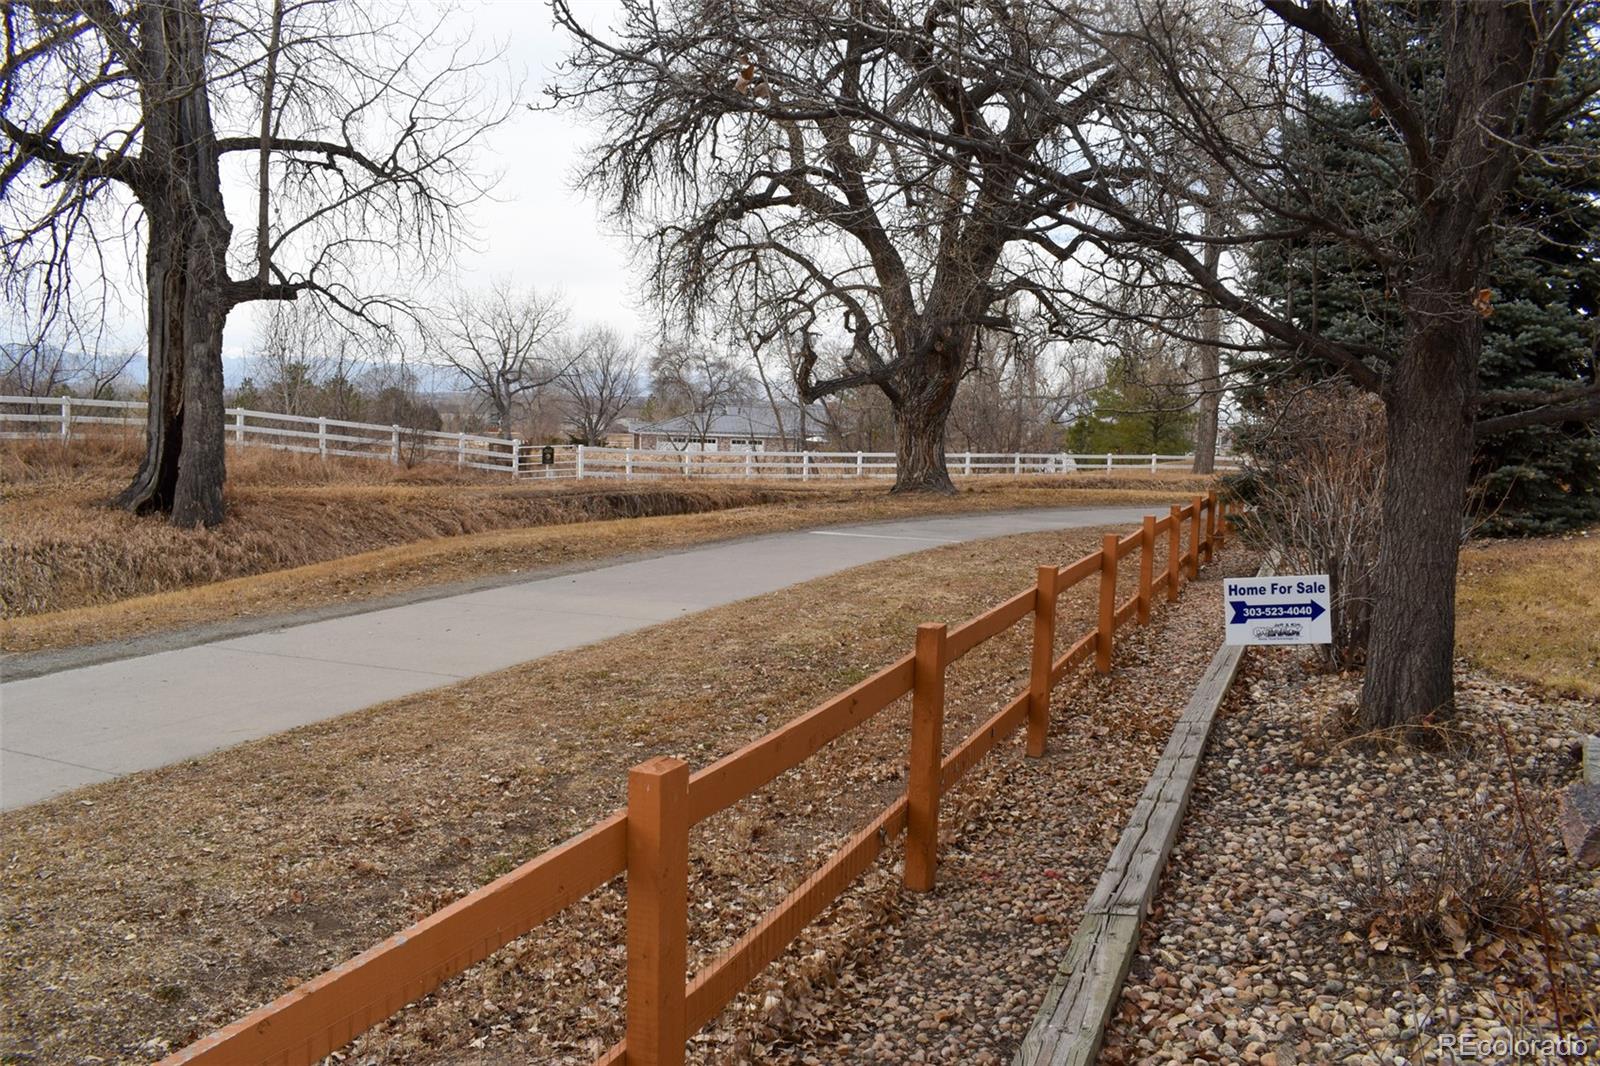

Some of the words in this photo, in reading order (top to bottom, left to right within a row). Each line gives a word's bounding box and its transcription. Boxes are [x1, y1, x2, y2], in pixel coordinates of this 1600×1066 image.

[1228, 584, 1266, 596] Home
[1271, 583, 1292, 595] For
[1296, 582, 1326, 594] Sale
[1243, 606, 1312, 616] 303-523-4040
